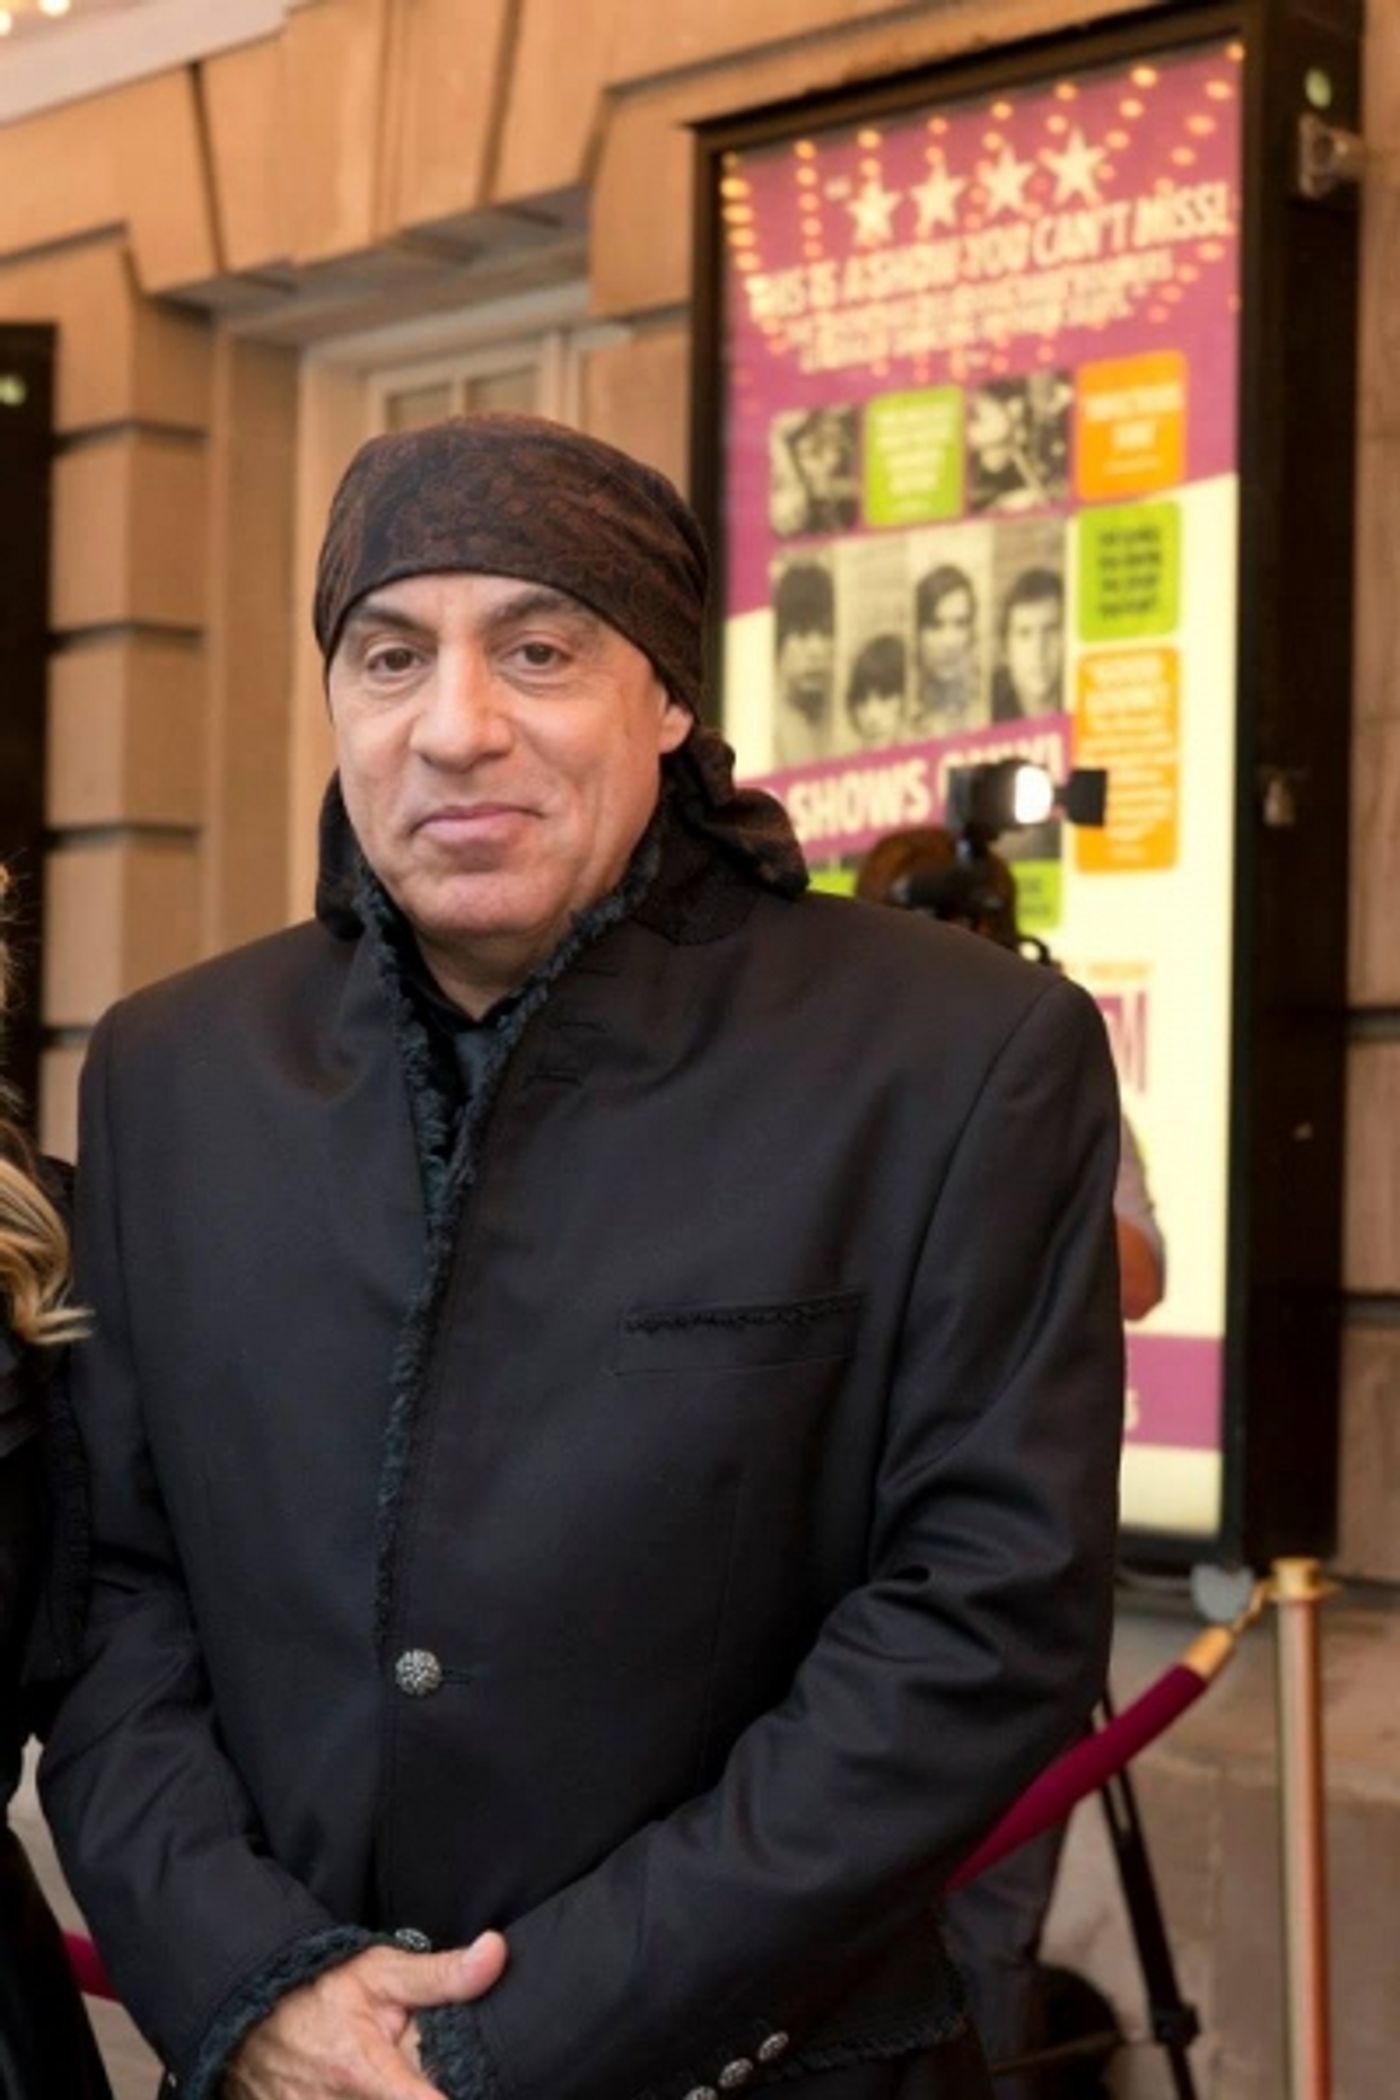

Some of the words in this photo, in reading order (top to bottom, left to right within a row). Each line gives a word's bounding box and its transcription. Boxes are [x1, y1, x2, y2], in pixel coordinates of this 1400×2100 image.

[1032, 201, 1132, 268] CAN'T
[1132, 181, 1229, 248] MISS!
[787, 757, 931, 842] SHOWS
